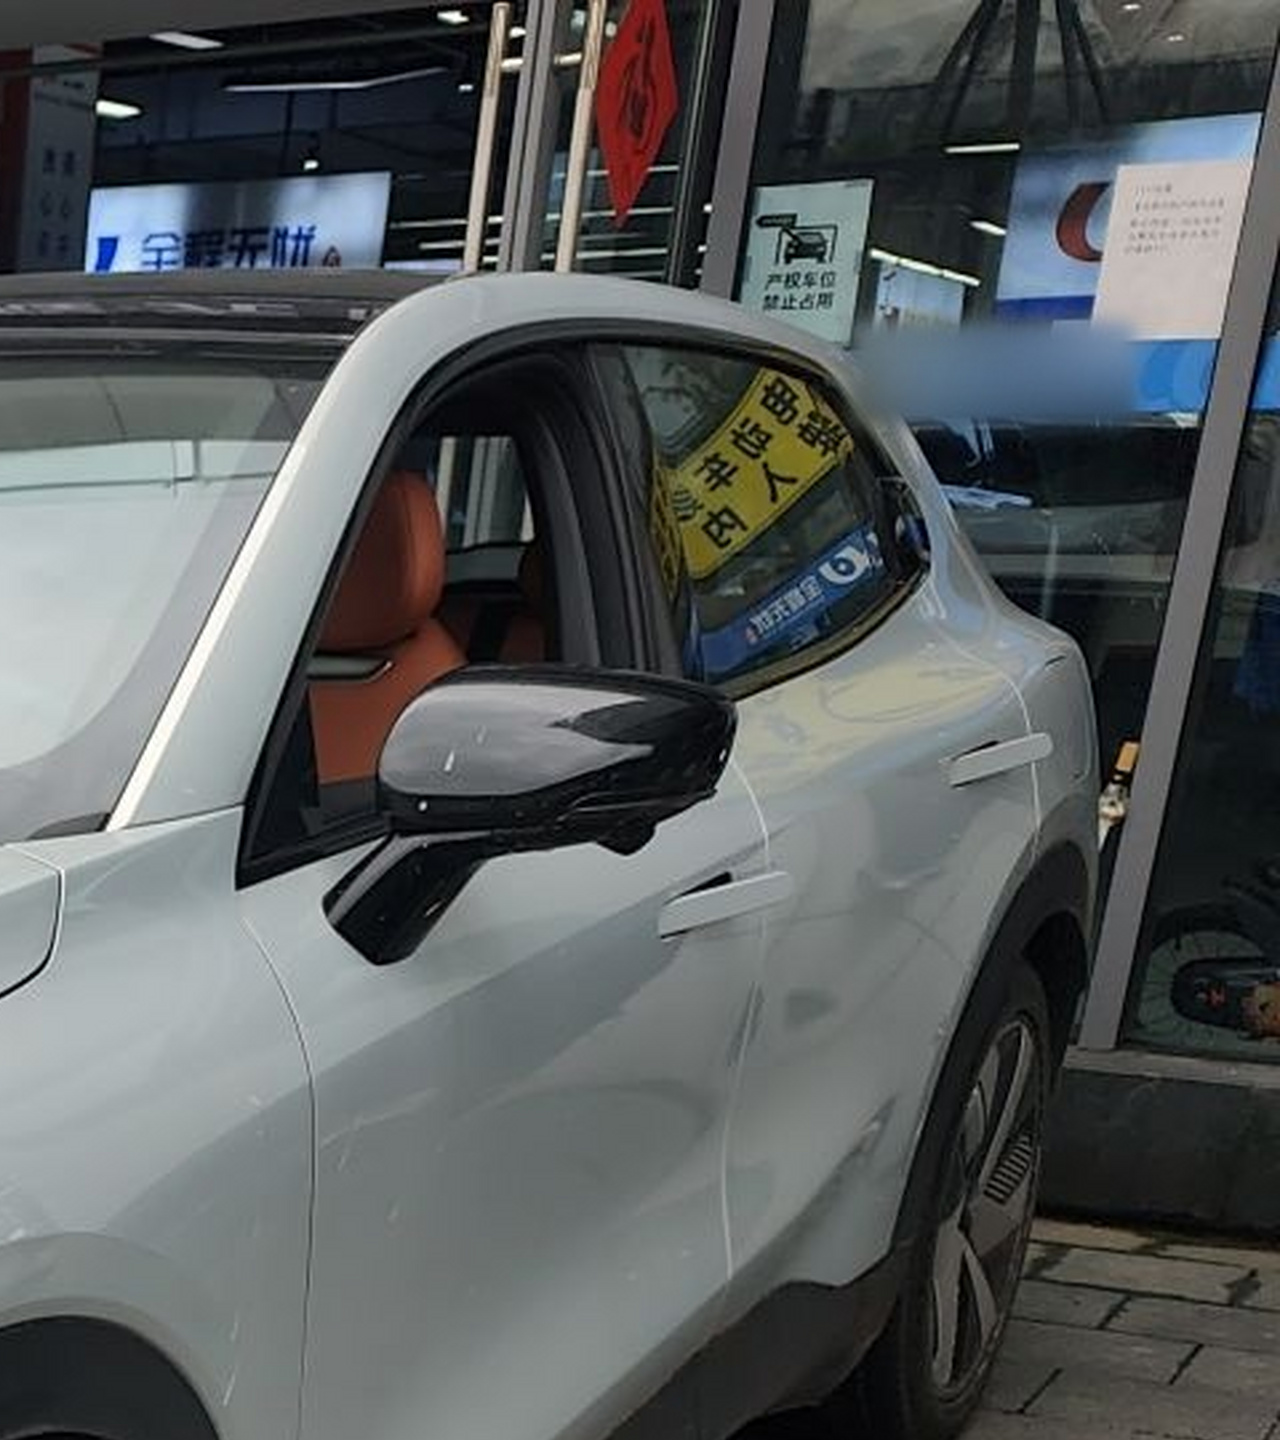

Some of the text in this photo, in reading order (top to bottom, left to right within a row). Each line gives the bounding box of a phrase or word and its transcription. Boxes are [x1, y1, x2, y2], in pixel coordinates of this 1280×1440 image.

[141, 224, 317, 270] 全程无忧
[765, 271, 836, 290] 产权车位
[762, 292, 834, 310] 禁止占用
